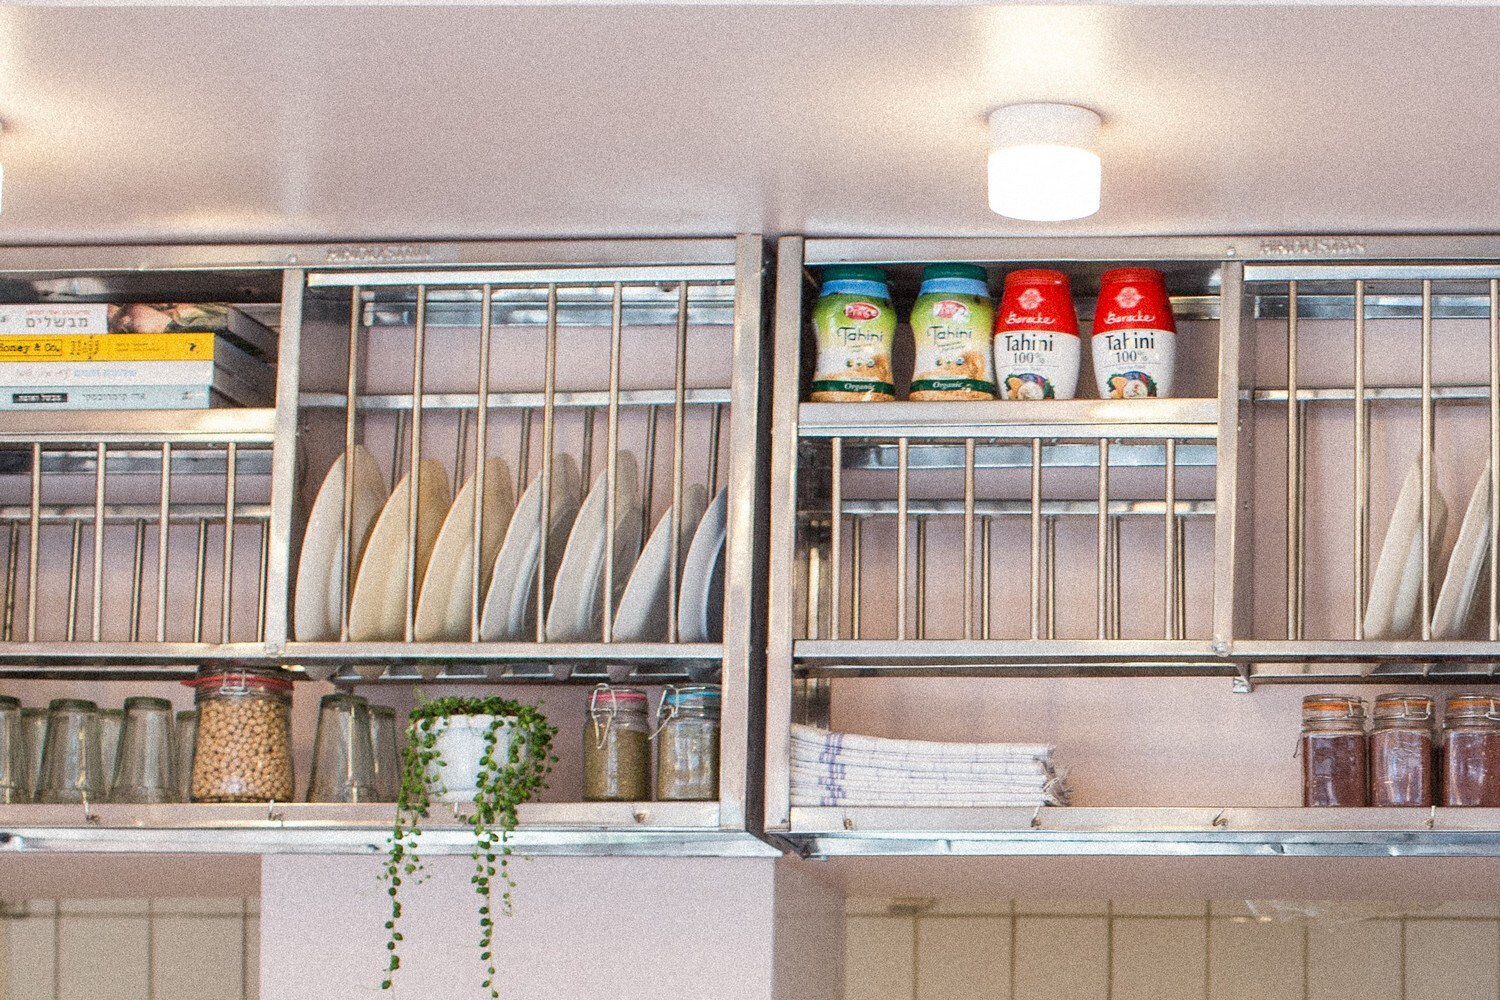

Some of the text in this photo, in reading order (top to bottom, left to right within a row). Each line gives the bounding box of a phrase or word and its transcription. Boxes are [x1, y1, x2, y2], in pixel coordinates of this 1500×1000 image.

[26, 315, 89, 329] מבשלים
[837, 326, 884, 346] Tahini
[927, 325, 973, 346] Tahini
[1105, 331, 1155, 350] Tahini
[45, 344, 61, 353] Co.
[1005, 333, 1054, 352] Tahini
[1013, 352, 1045, 364] 100%
[1116, 350, 1148, 363] 100%
[844, 382, 875, 391] Organic
[932, 382, 963, 391] Organic
